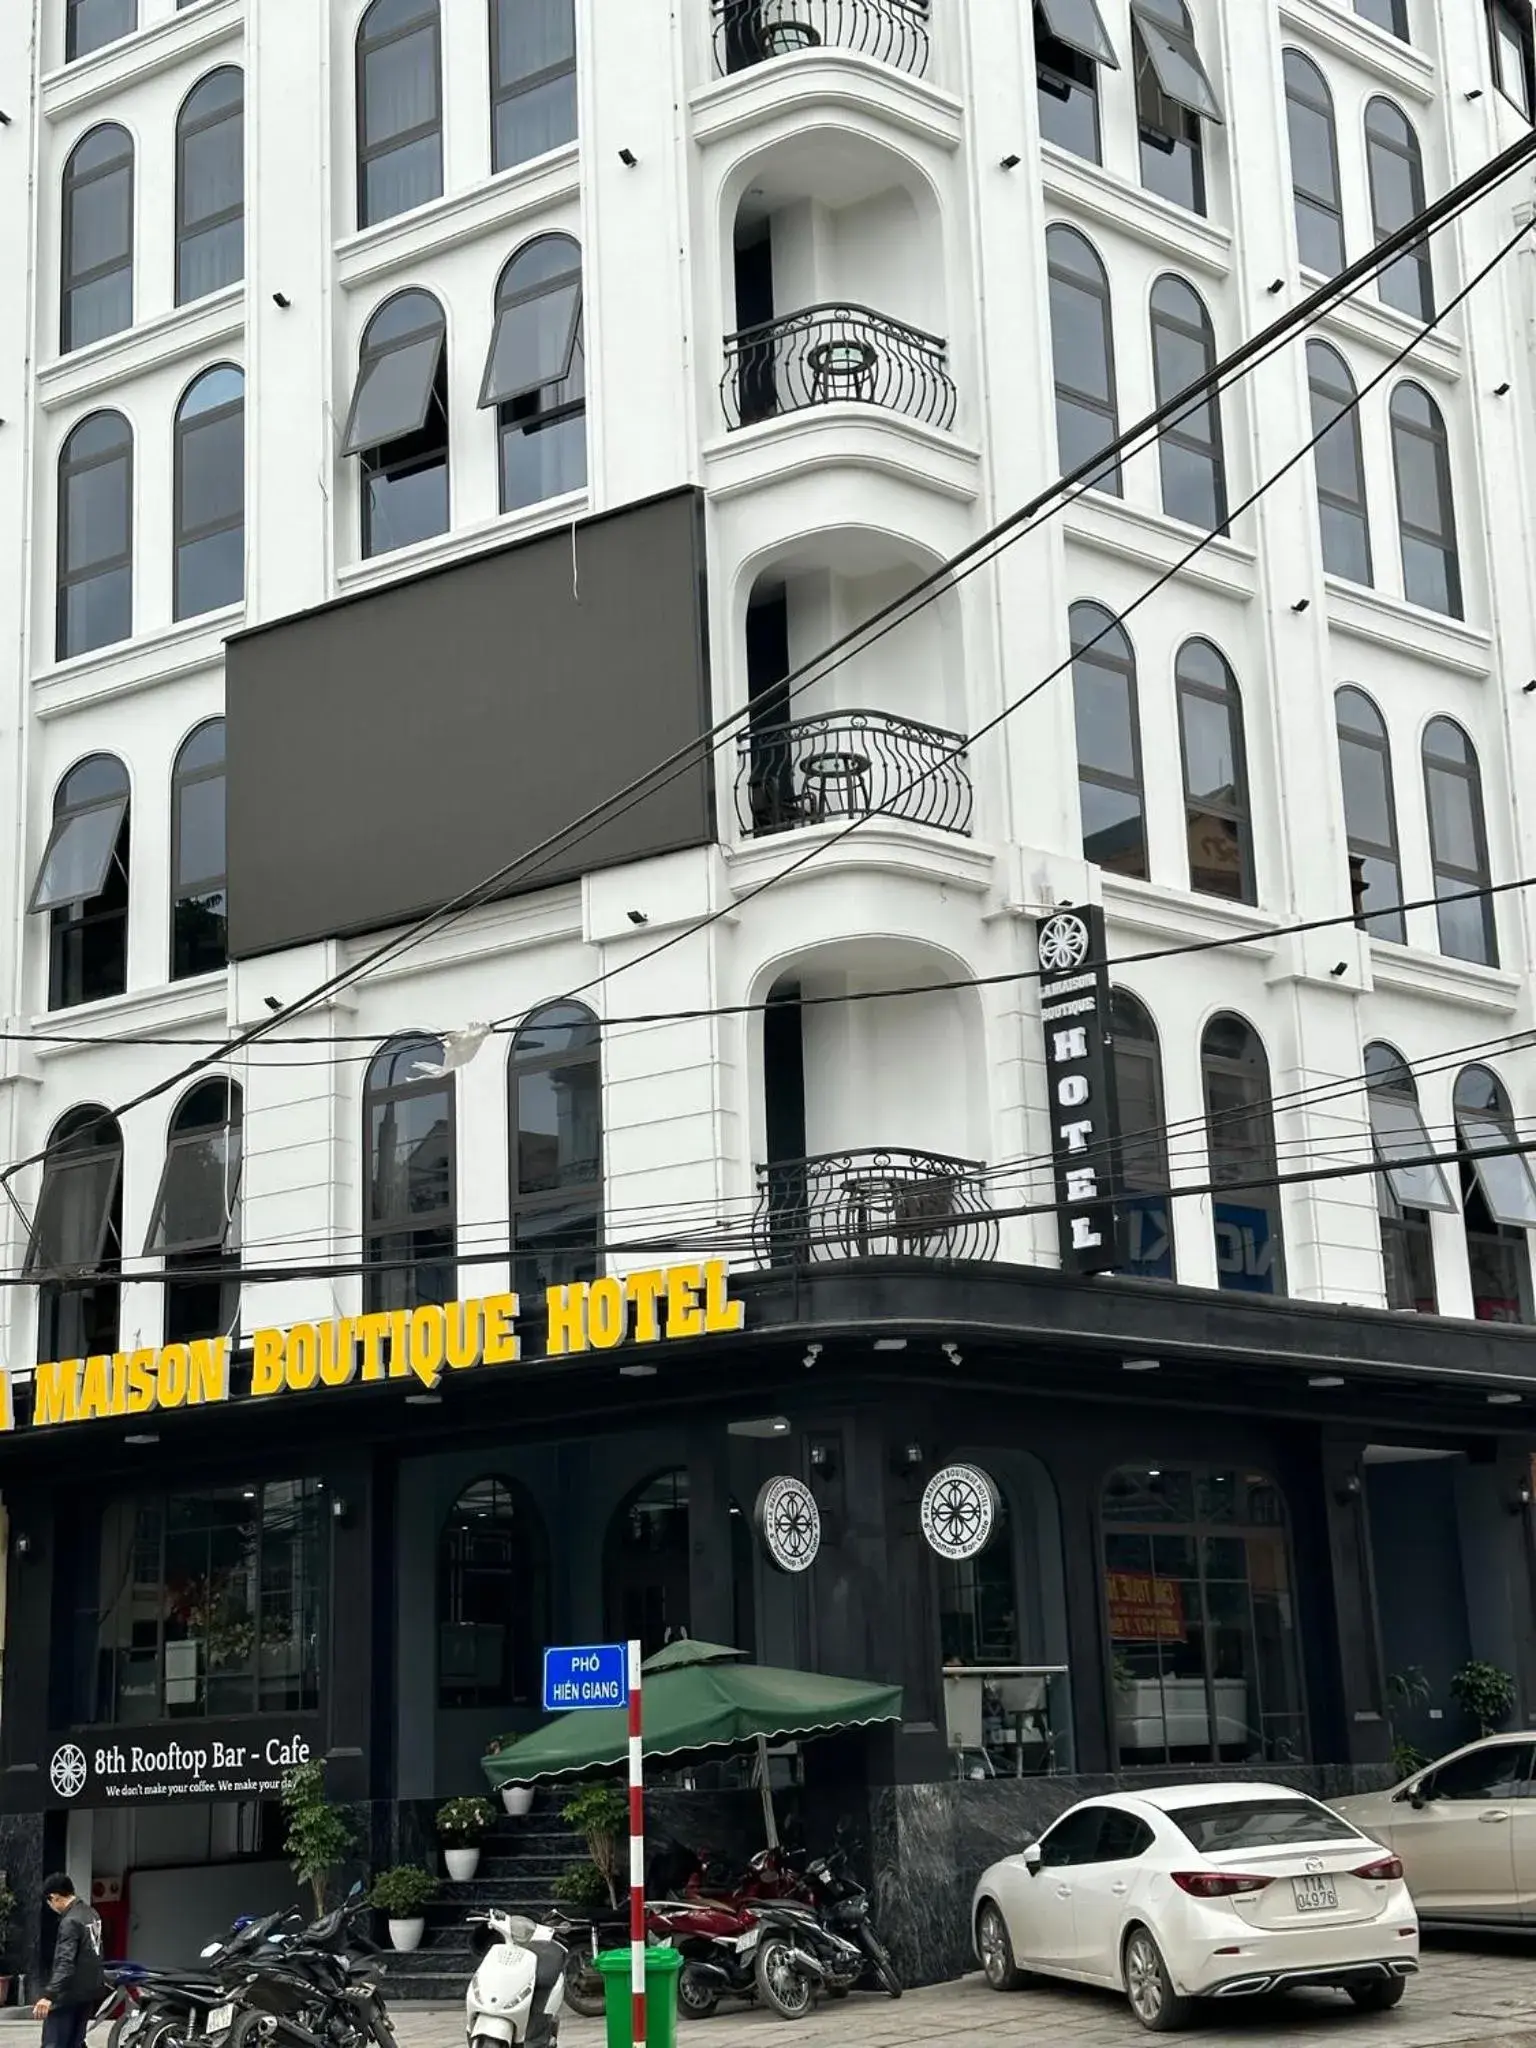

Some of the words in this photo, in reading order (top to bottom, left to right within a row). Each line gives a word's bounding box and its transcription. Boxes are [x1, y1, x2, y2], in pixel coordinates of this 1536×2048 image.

[1053, 1026, 1101, 1249] HOTEL
[33, 1335, 232, 1426] MAISON
[250, 1293, 521, 1396] BOUTIQUE
[546, 1257, 745, 1355] HOTEL
[582, 1680, 618, 1700] GIANG
[95, 1746, 127, 1774] 8th
[131, 1742, 207, 1778] Rooftop
[212, 1742, 246, 1768] Bar
[265, 1734, 310, 1765] Cafe
[105, 1786, 120, 1796] We
[121, 1784, 142, 1795] don't
[144, 1782, 167, 1795] make
[168, 1784, 188, 1797] your
[189, 1780, 216, 1793] coffee.
[218, 1780, 232, 1791] We
[234, 1778, 257, 1791] make
[258, 1780, 280, 1793] your
[1304, 1876, 1325, 1893] 11A
[1298, 1890, 1336, 1908] 04976
